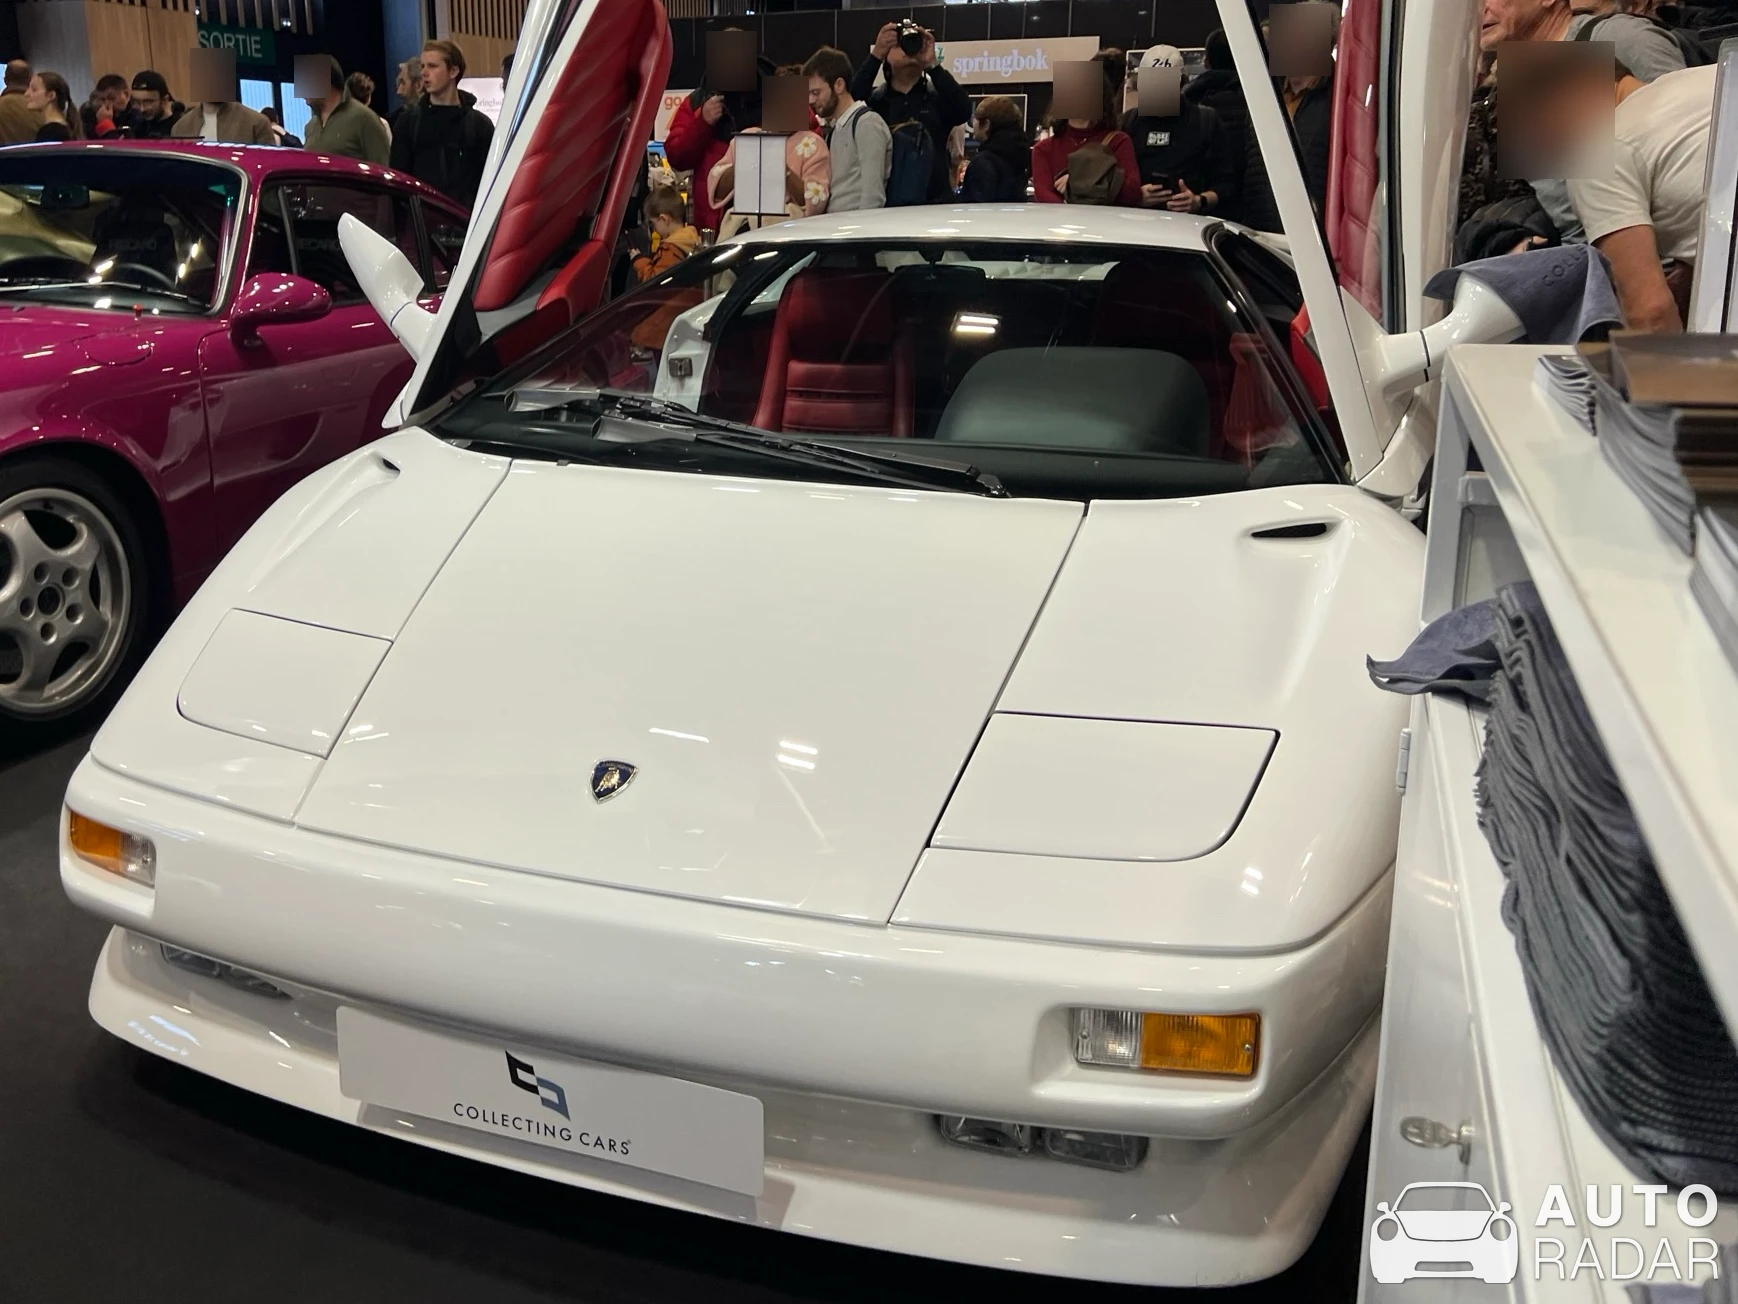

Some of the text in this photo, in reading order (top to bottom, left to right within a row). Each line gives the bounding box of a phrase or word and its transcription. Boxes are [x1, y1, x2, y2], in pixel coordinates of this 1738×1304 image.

[198, 30, 262, 58] SORTIE
[953, 48, 1049, 77] springbok
[453, 1102, 572, 1142] COLLECTING
